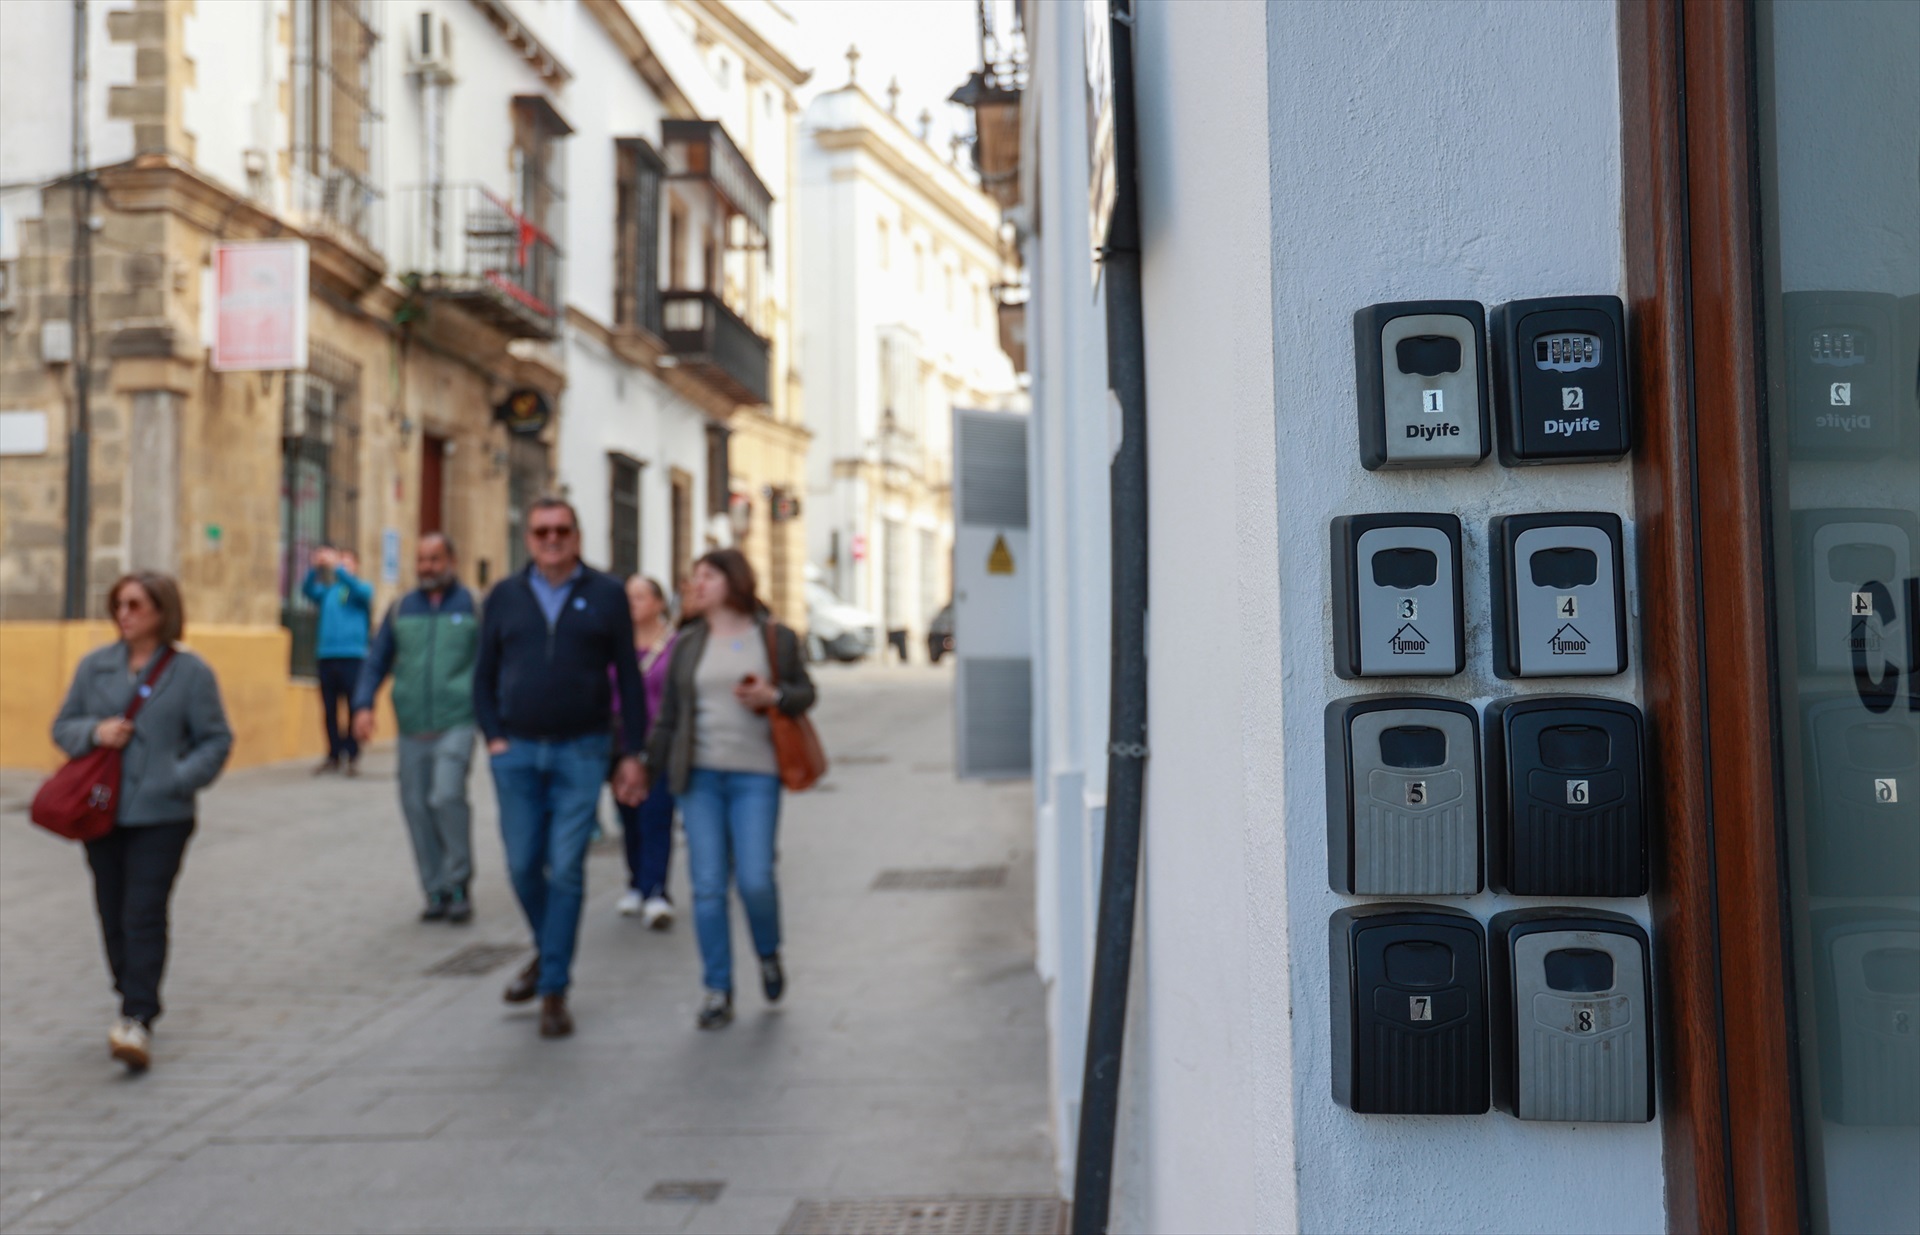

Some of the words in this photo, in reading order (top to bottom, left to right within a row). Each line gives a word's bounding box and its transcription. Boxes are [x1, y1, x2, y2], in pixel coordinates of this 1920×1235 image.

[1429, 392, 1439, 411] 1
[1567, 389, 1580, 409] 2
[1406, 423, 1460, 441] Diyife
[1544, 417, 1600, 437] Diyife
[1402, 599, 1414, 618] 3
[1562, 597, 1575, 617] 4
[1851, 580, 1920, 714] C
[1411, 783, 1423, 803] 5
[1572, 782, 1585, 803] 6
[1415, 998, 1427, 1019] 7
[1578, 1010, 1592, 1032] 8
